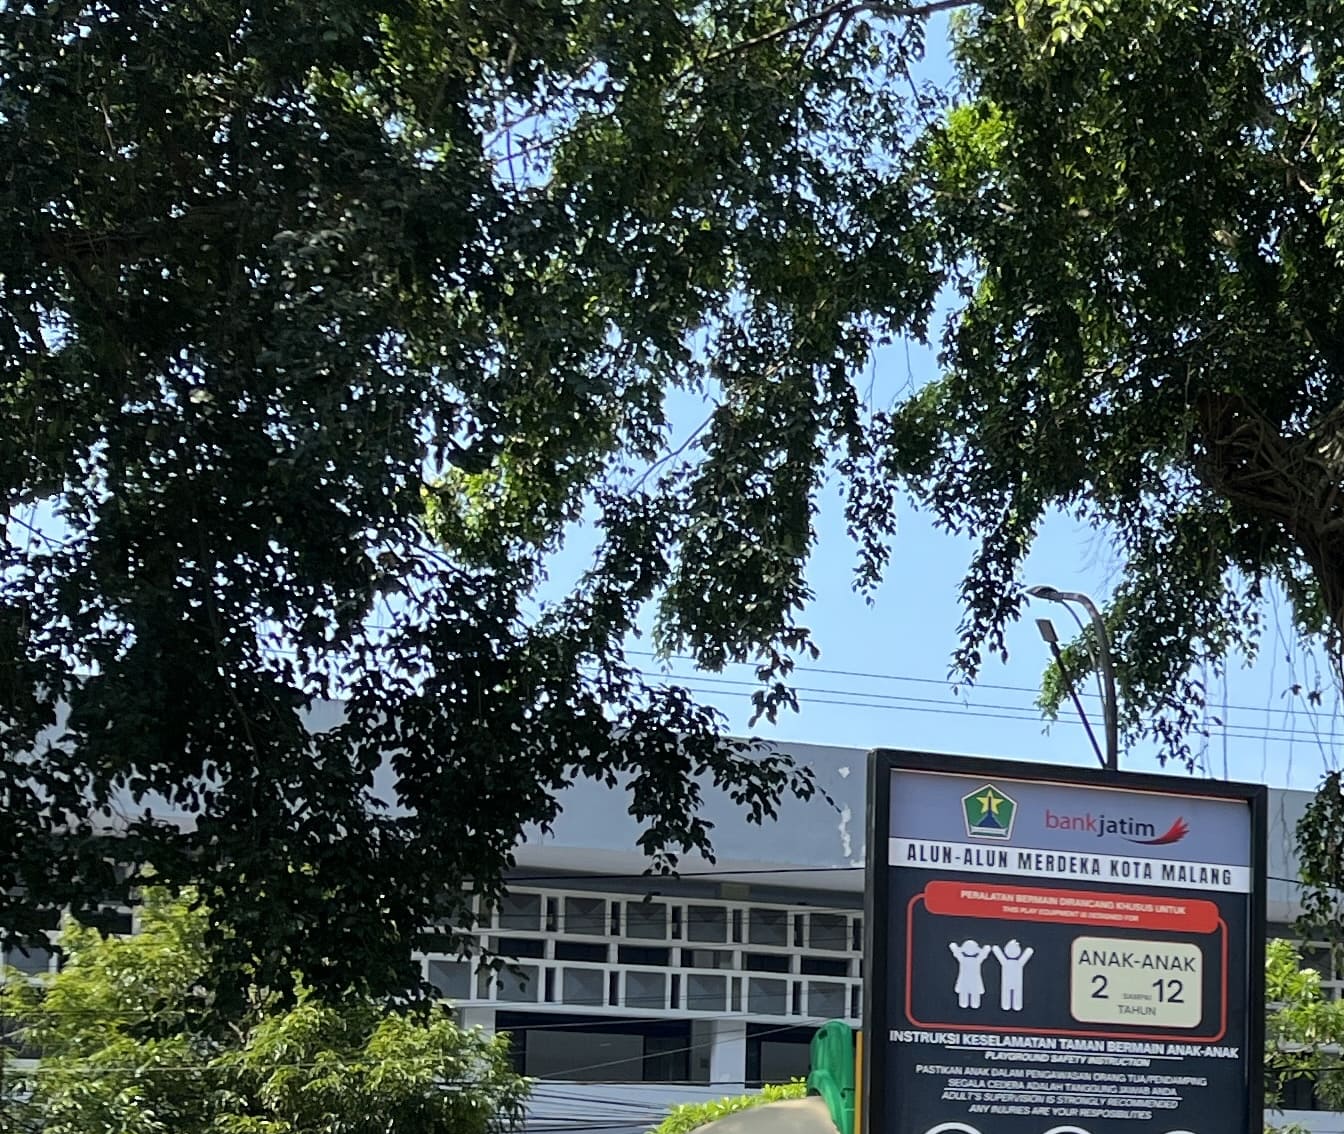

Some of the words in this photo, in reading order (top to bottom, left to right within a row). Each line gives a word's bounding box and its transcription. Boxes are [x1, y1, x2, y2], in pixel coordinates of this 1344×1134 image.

[907, 843, 1008, 868] ALUN-ALUN
[1018, 852, 1100, 876] MERDEKA
[1110, 859, 1152, 880] KOTA
[1161, 864, 1232, 885] MALANG
[1078, 949, 1196, 973] ANAK-ANAK
[1091, 974, 1110, 999] 2
[1152, 978, 1185, 1004] 12
[1117, 1004, 1157, 1016] TAHUN
[889, 1030, 961, 1045] INSTRUKSI
[962, 1034, 1057, 1049] KESELAMATAN
[1059, 1038, 1105, 1052] TAMAN
[1106, 1041, 1165, 1055] BERMAIN
[1166, 1044, 1240, 1059] ANAK-ANAK
[916, 1064, 963, 1075] PASTIKAN
